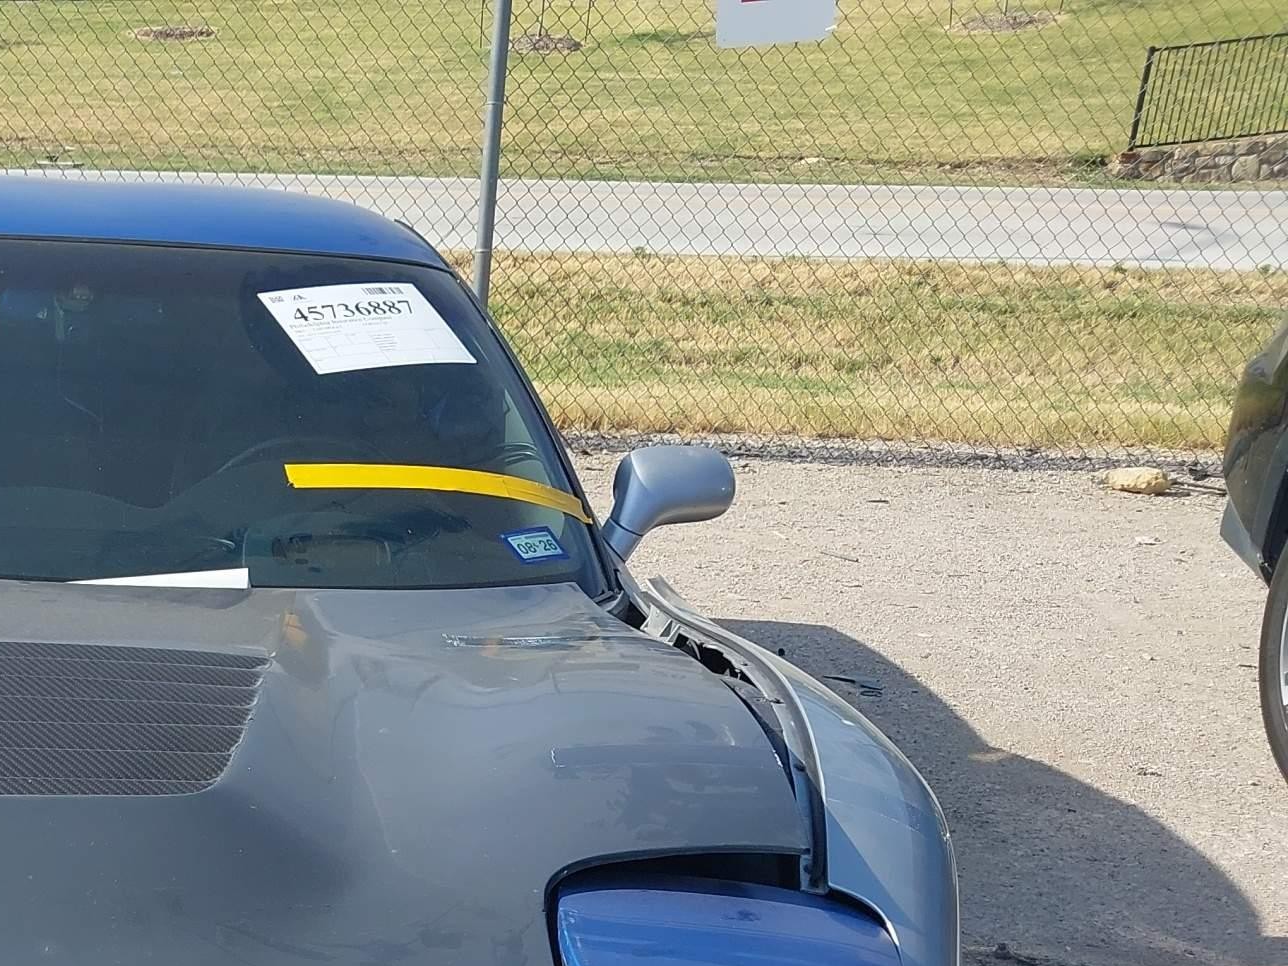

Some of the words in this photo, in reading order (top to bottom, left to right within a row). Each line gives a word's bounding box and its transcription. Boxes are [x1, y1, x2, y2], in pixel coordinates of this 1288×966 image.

[293, 299, 413, 322] 45736887
[516, 541, 538, 555] 08
[538, 539, 558, 552] 26
